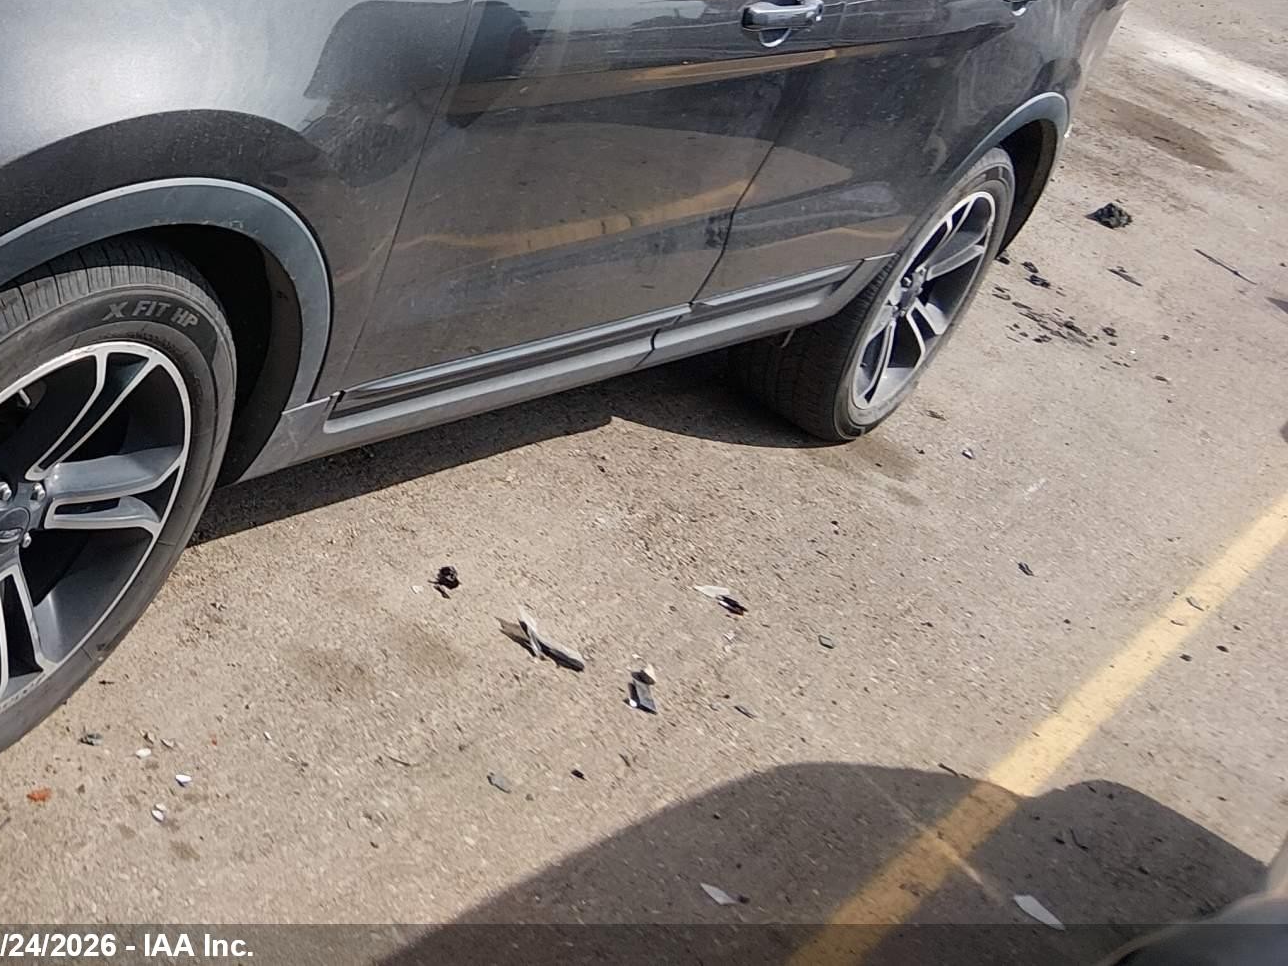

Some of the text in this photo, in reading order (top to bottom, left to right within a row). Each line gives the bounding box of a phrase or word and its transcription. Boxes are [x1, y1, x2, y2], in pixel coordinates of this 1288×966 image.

[102, 300, 199, 327] X FIT HP
